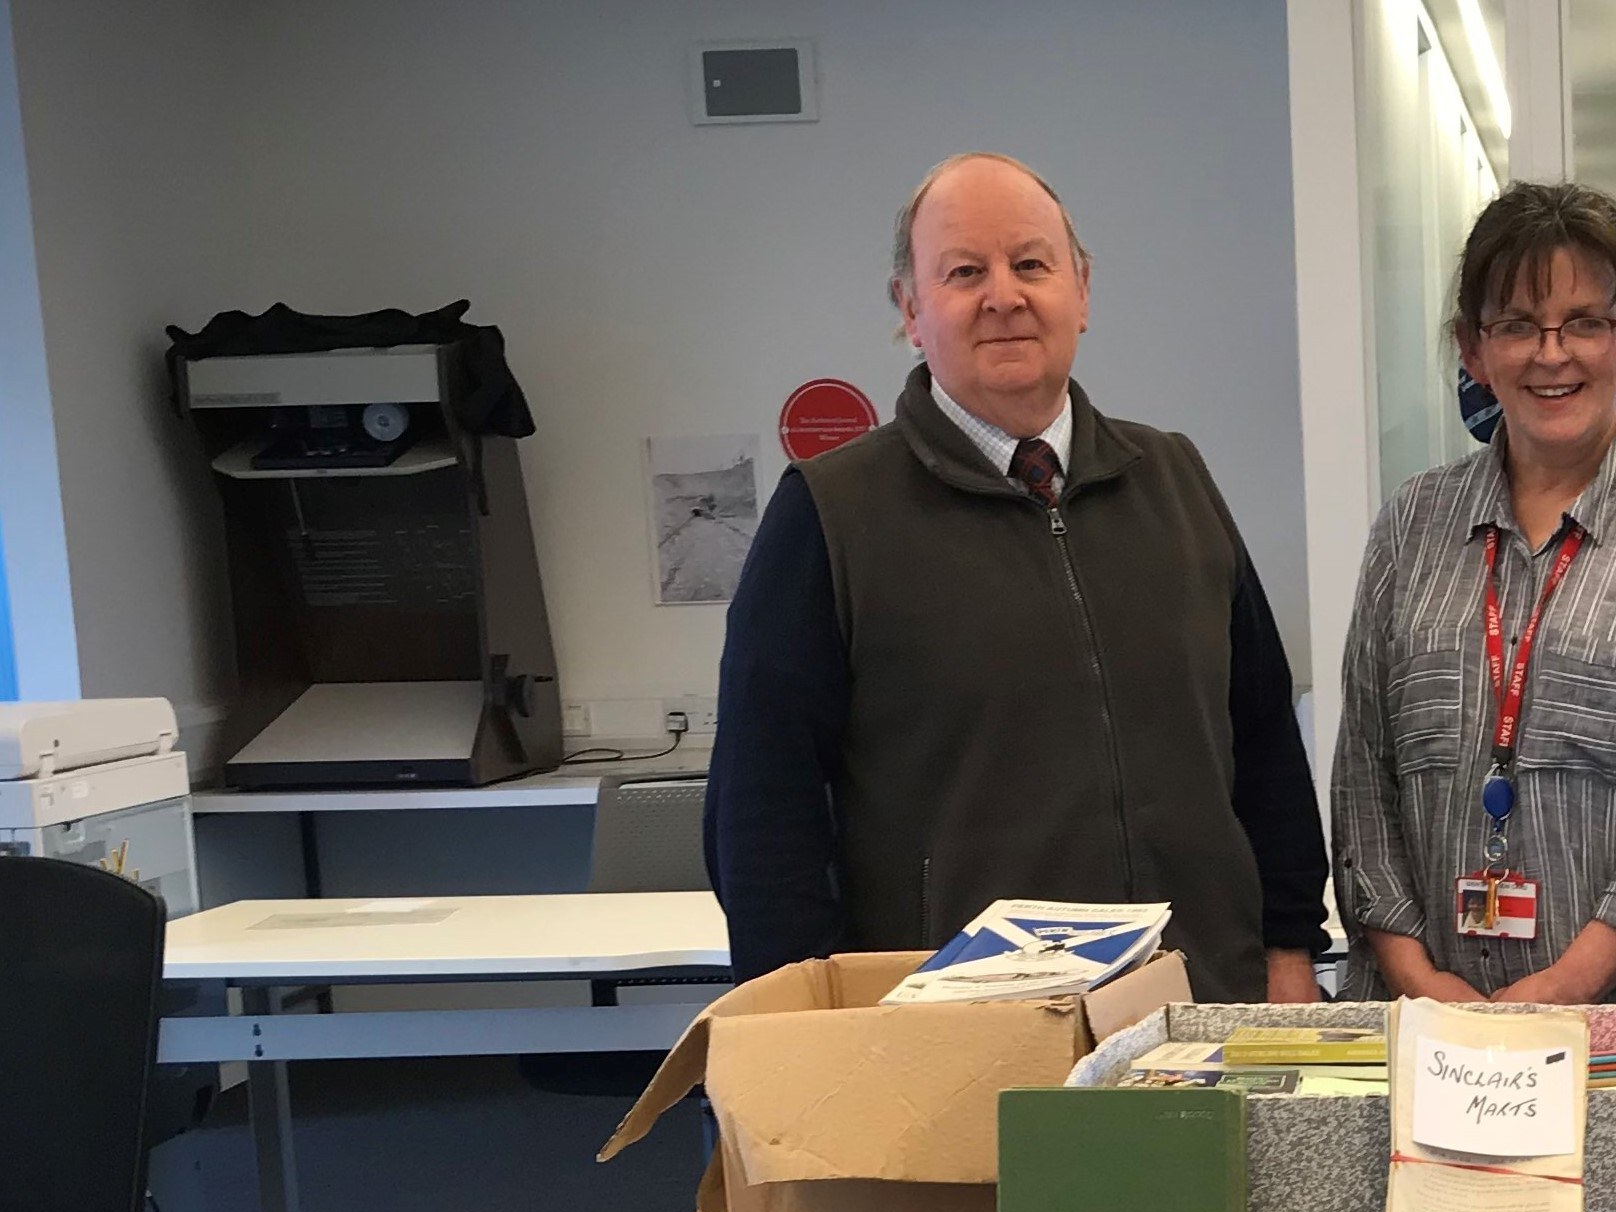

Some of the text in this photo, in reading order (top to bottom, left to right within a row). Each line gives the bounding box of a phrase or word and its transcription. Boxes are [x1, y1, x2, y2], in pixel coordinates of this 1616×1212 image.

[1510, 662, 1526, 697] STAFF
[1427, 1050, 1539, 1090] SINCLAIR'S
[1465, 1095, 1539, 1125] MARTS
